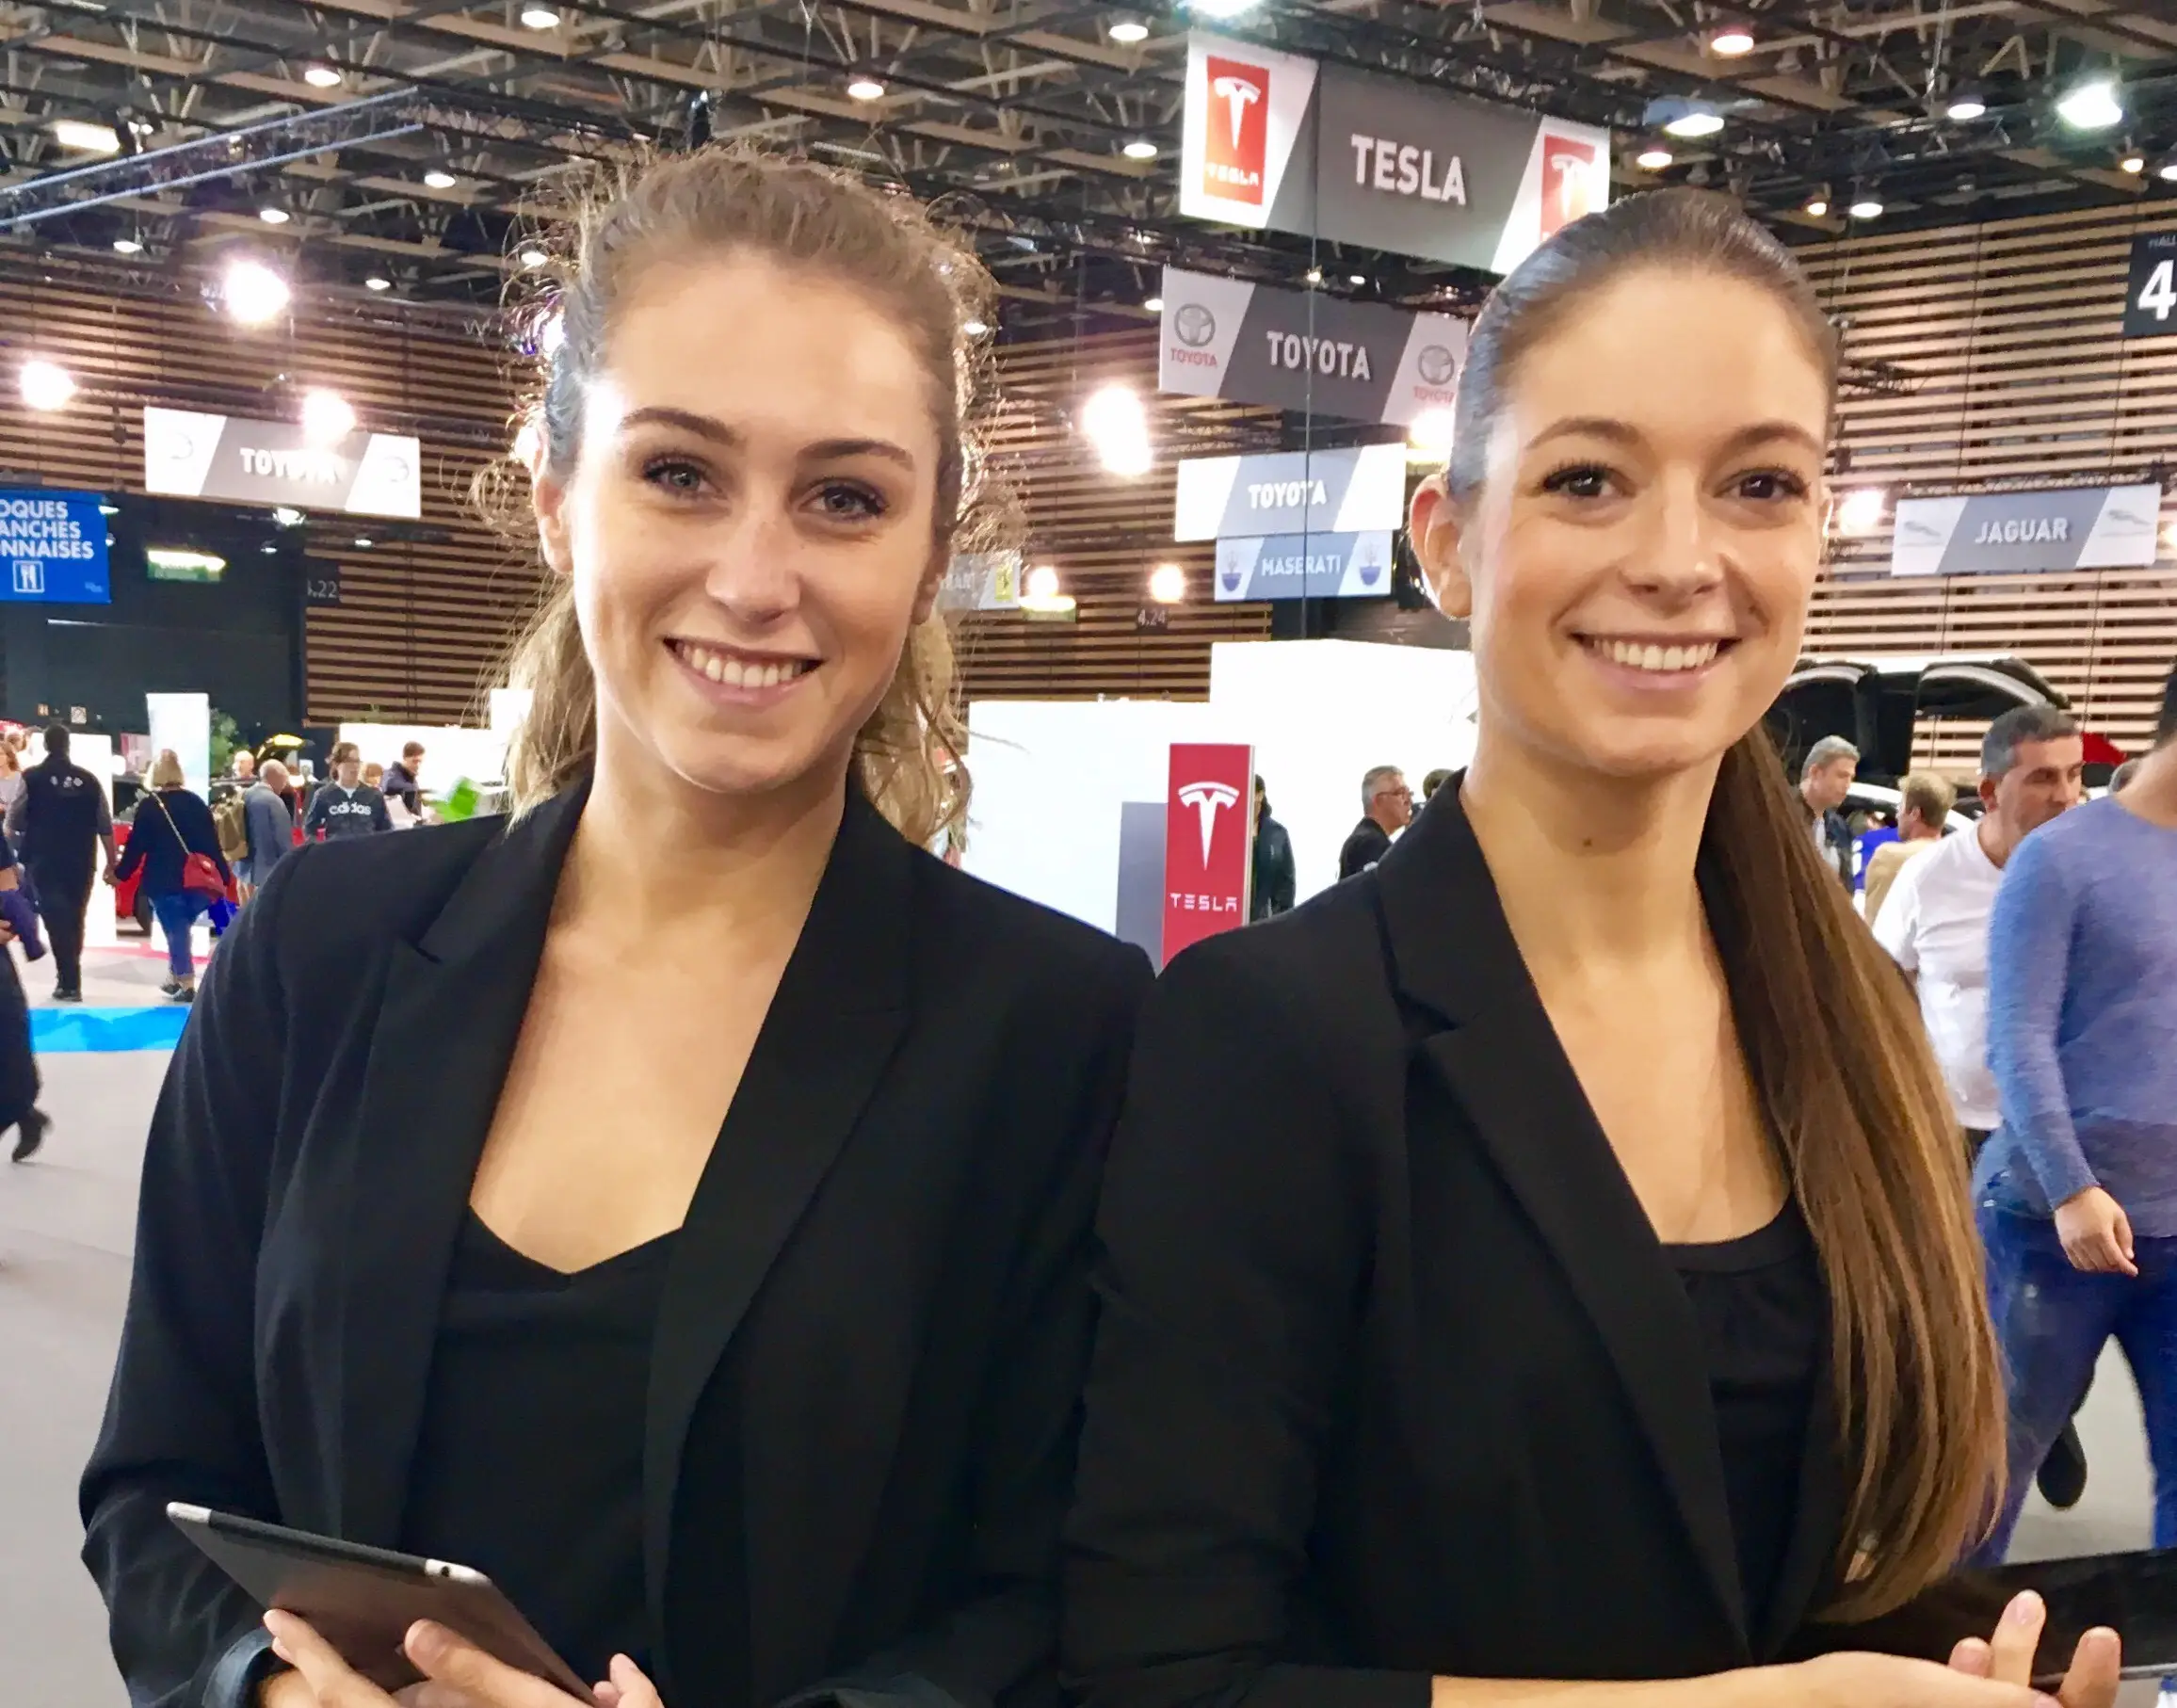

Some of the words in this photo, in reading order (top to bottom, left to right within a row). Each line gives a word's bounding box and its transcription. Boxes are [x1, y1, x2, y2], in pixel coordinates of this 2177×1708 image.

[1205, 161, 1259, 187] TESLA
[1350, 134, 1466, 206] TESLA
[2137, 260, 2177, 320] 4
[1170, 347, 1218, 367] TOYOTA
[1266, 330, 1371, 381] TOYOTA
[1248, 479, 1327, 509] TOYOTA
[1975, 517, 2069, 544] JAGUAR
[0, 539, 94, 559] NNAISES
[1262, 555, 1341, 576] MASERATI
[1169, 892, 1237, 912] TESLA
